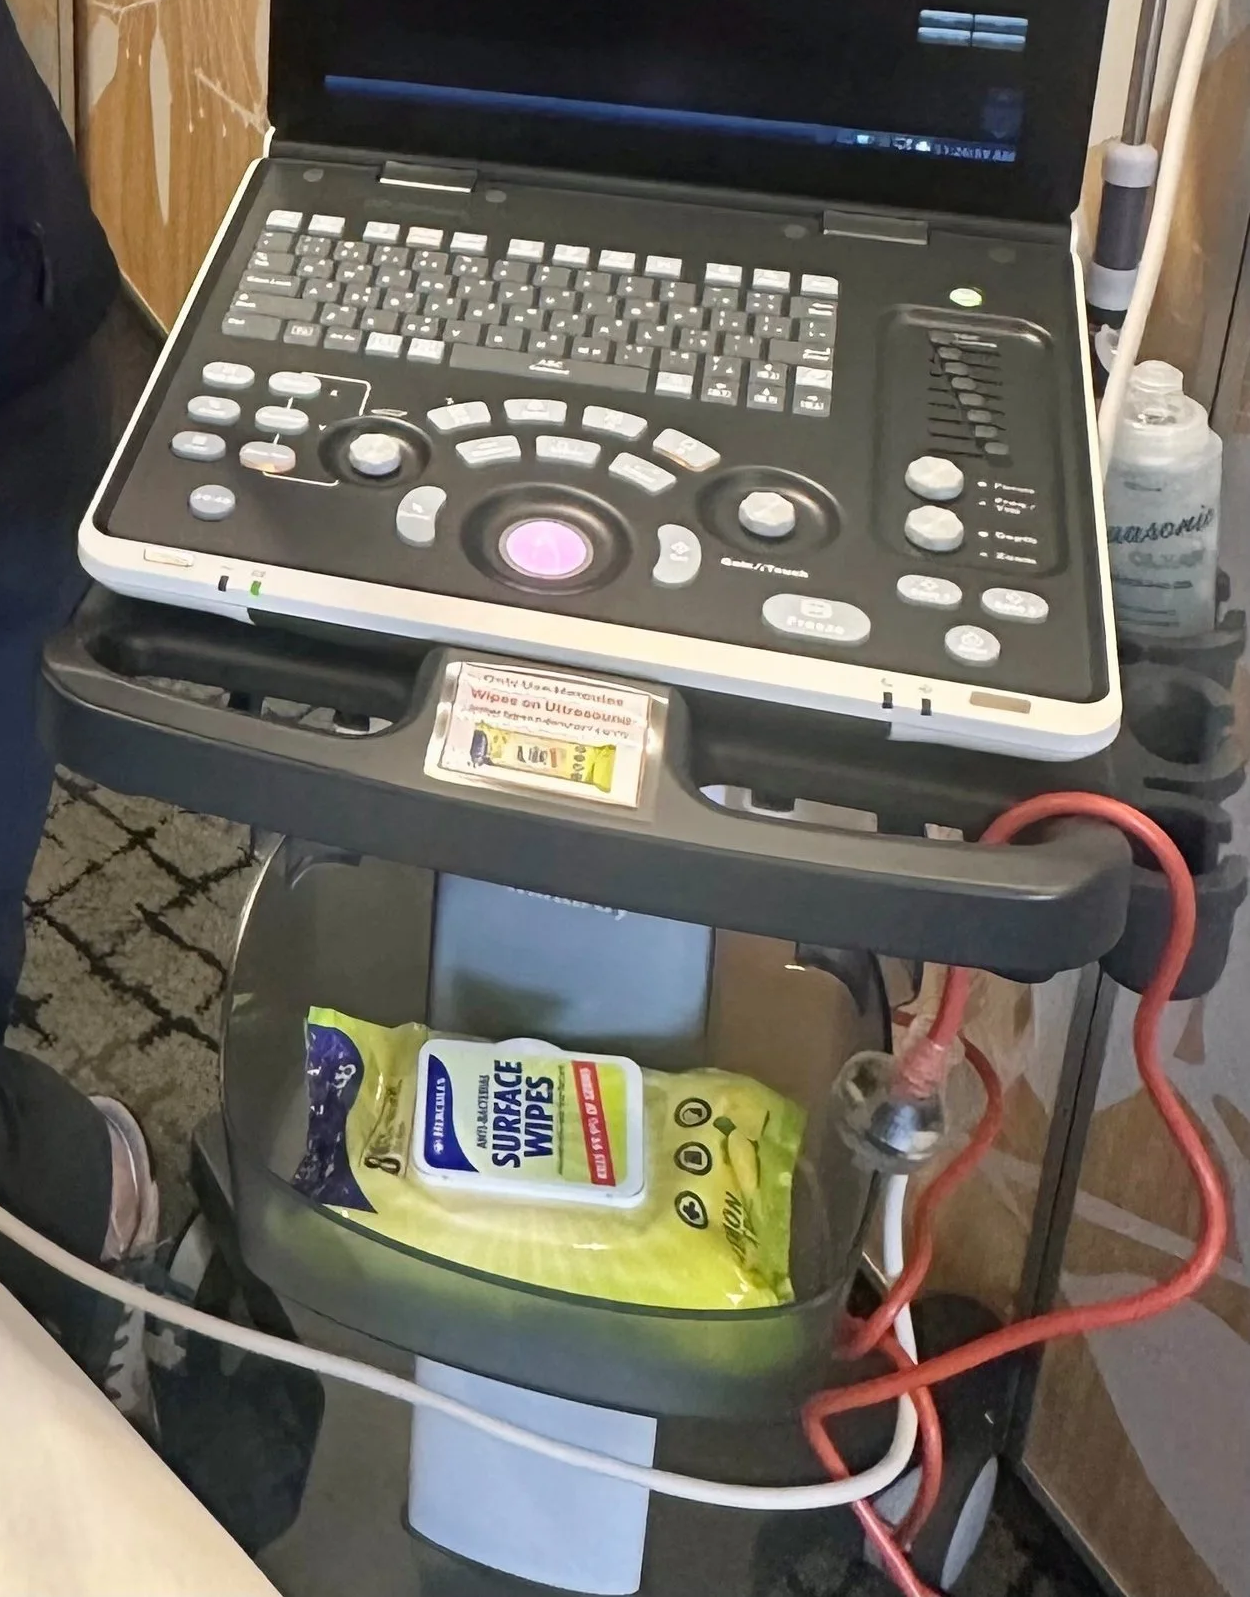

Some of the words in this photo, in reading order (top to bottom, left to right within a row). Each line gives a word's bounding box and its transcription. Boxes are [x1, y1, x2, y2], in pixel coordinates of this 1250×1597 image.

[471, 687, 518, 706] Wipes
[521, 700, 542, 710] on
[491, 1059, 523, 1169] SURFACE
[523, 1076, 554, 1158] WIPES
